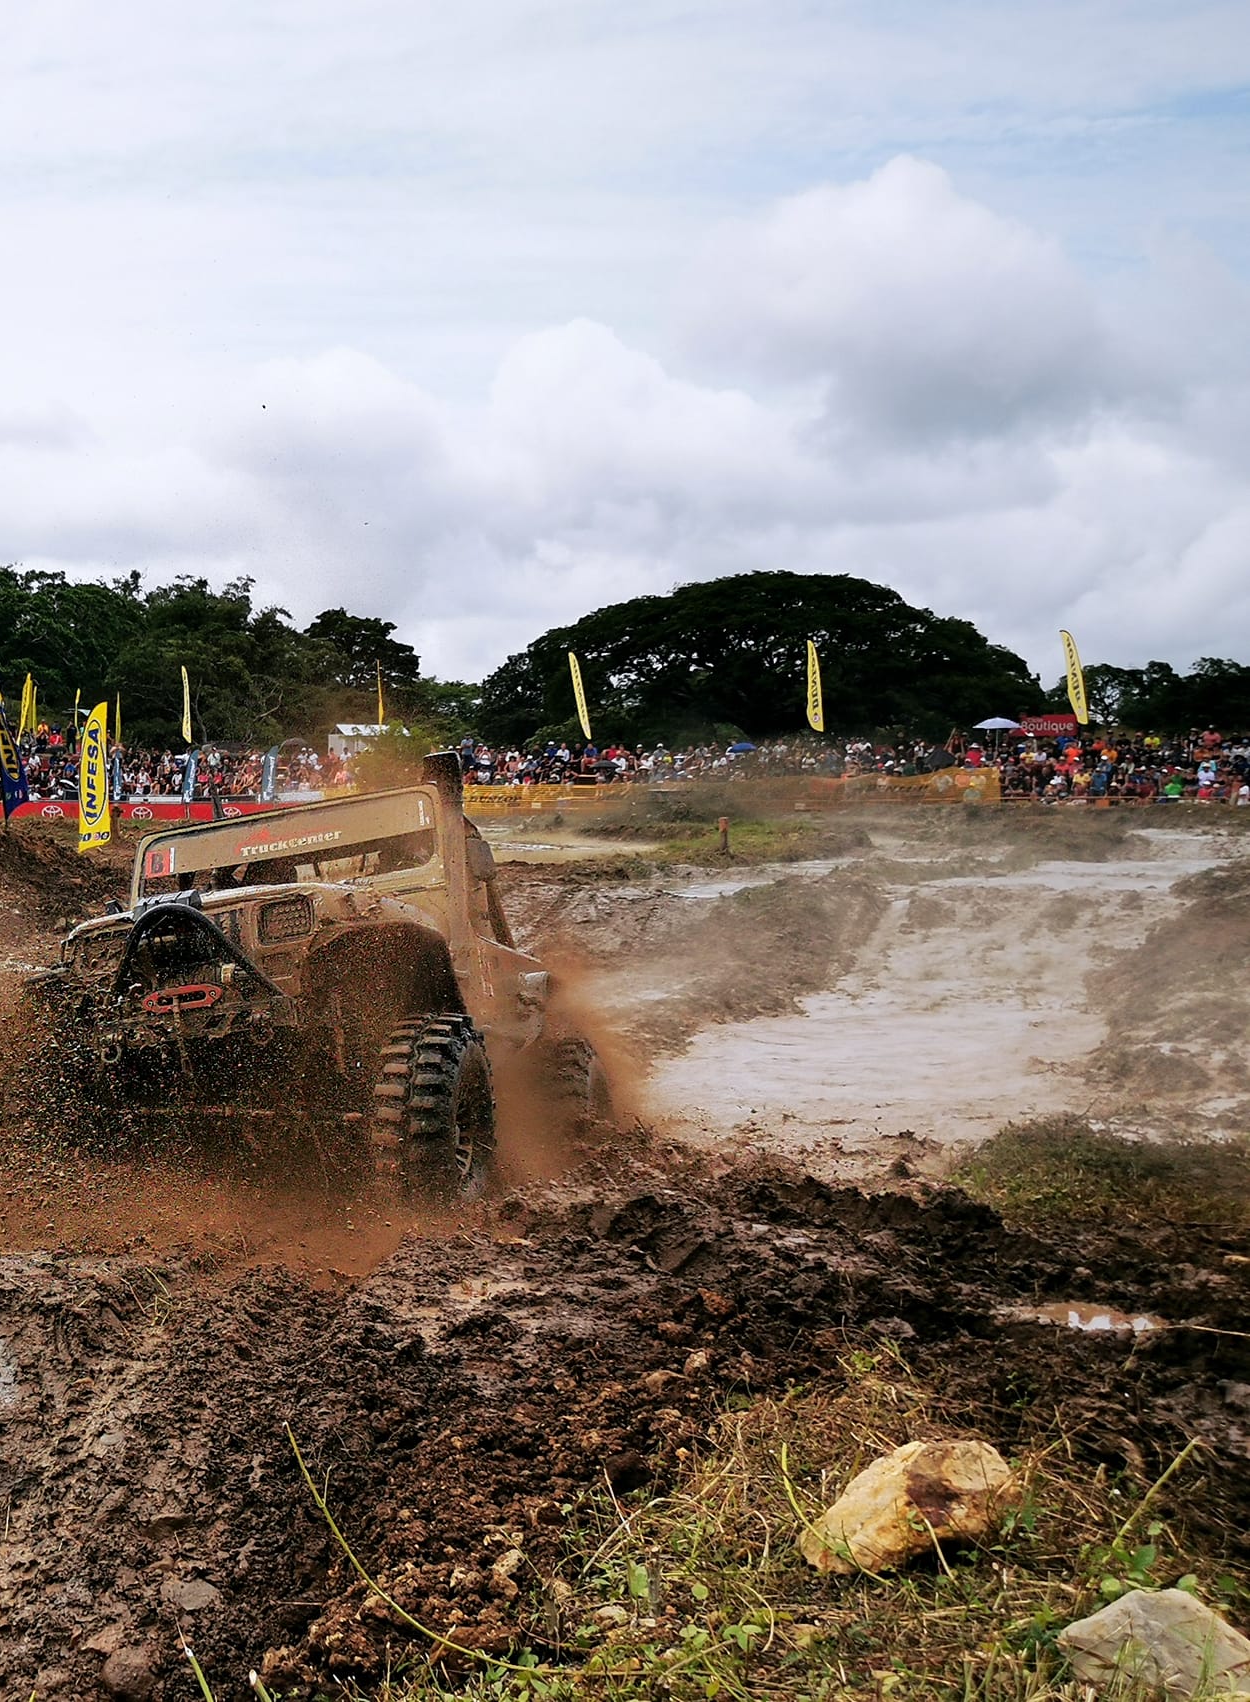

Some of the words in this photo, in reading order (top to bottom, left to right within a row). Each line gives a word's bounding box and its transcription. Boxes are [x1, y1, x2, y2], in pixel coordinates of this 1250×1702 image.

[1021, 720, 1074, 733] Boutique
[86, 728, 100, 819] INFESA
[240, 830, 342, 857] Truckcenter
